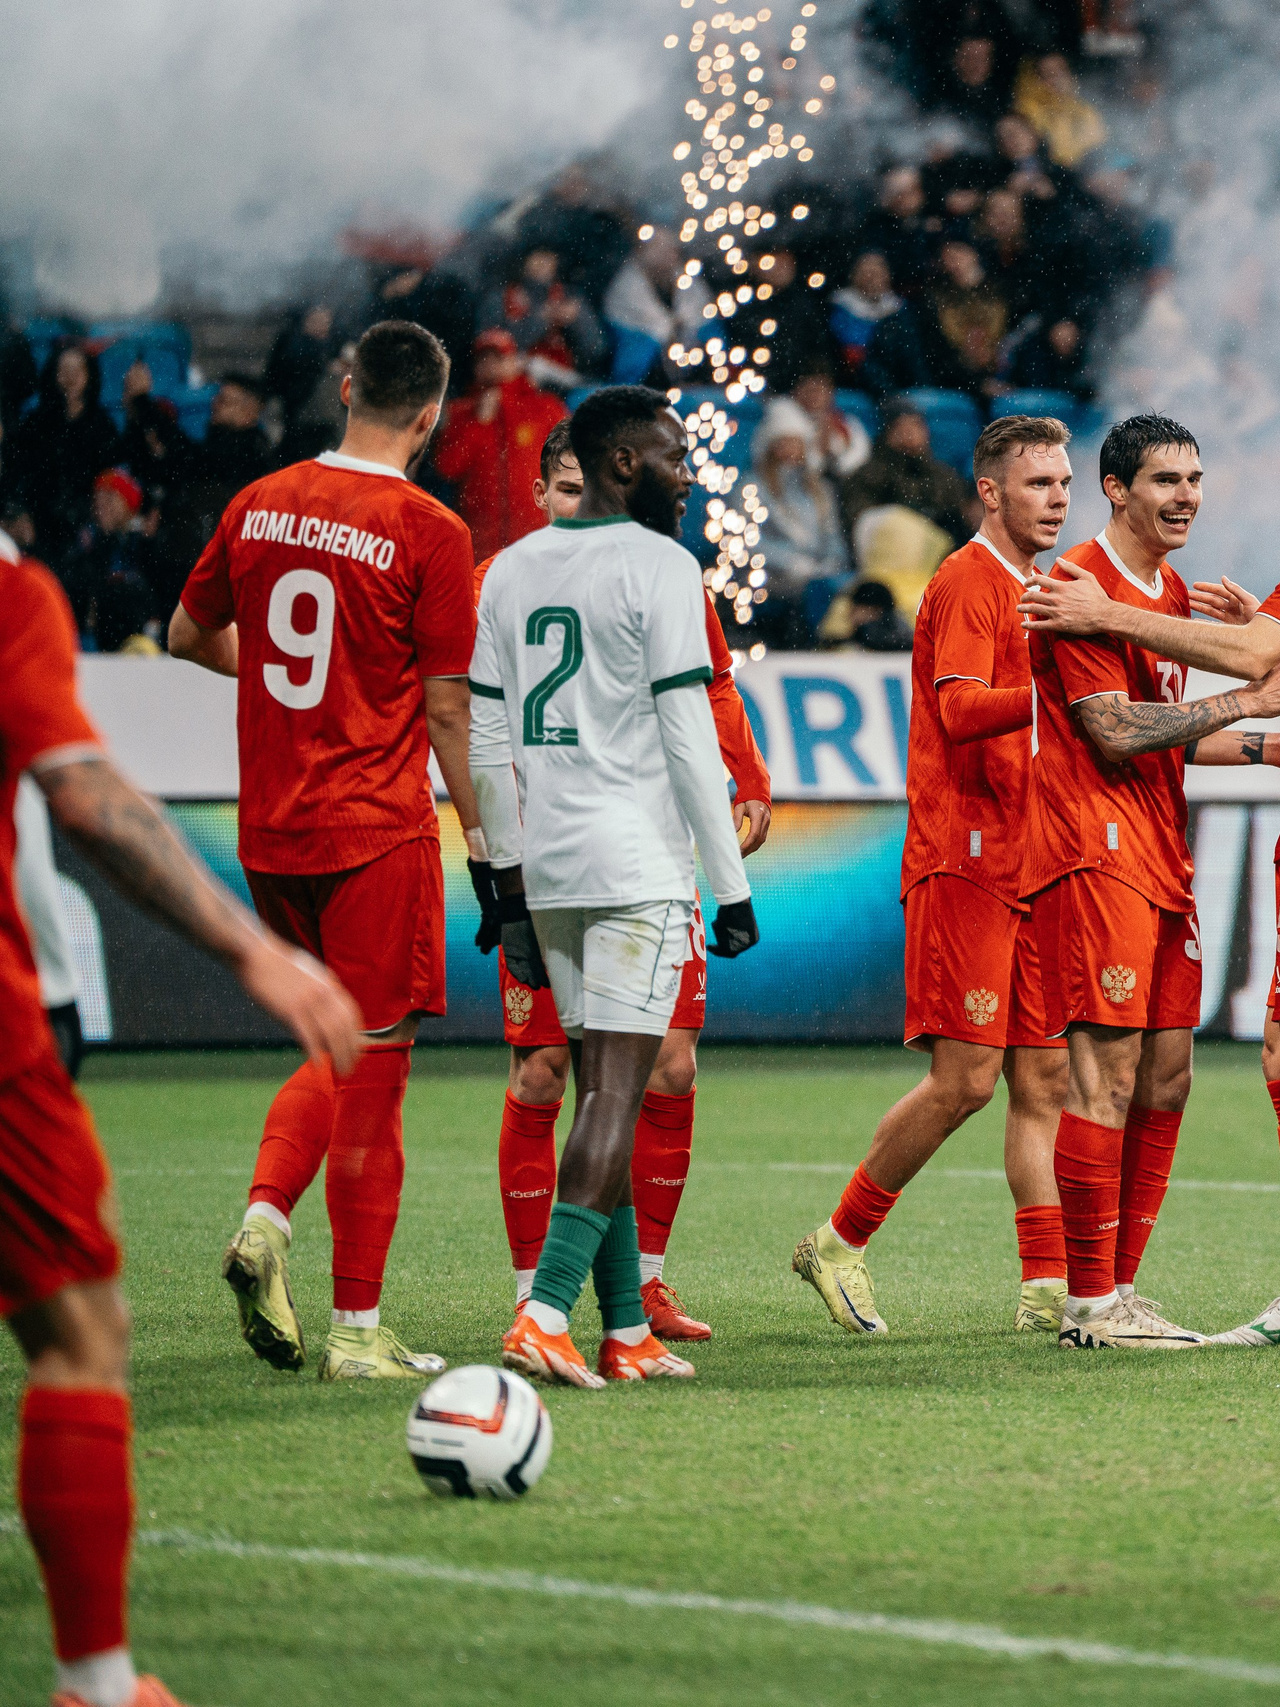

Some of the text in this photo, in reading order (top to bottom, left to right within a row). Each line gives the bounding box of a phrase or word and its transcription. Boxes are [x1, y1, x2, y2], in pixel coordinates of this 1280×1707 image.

[240, 509, 396, 571] KOMLICHENKO
[263, 568, 336, 710] 9
[523, 606, 584, 746] 2
[505, 1188, 550, 1199] JÖGEL
